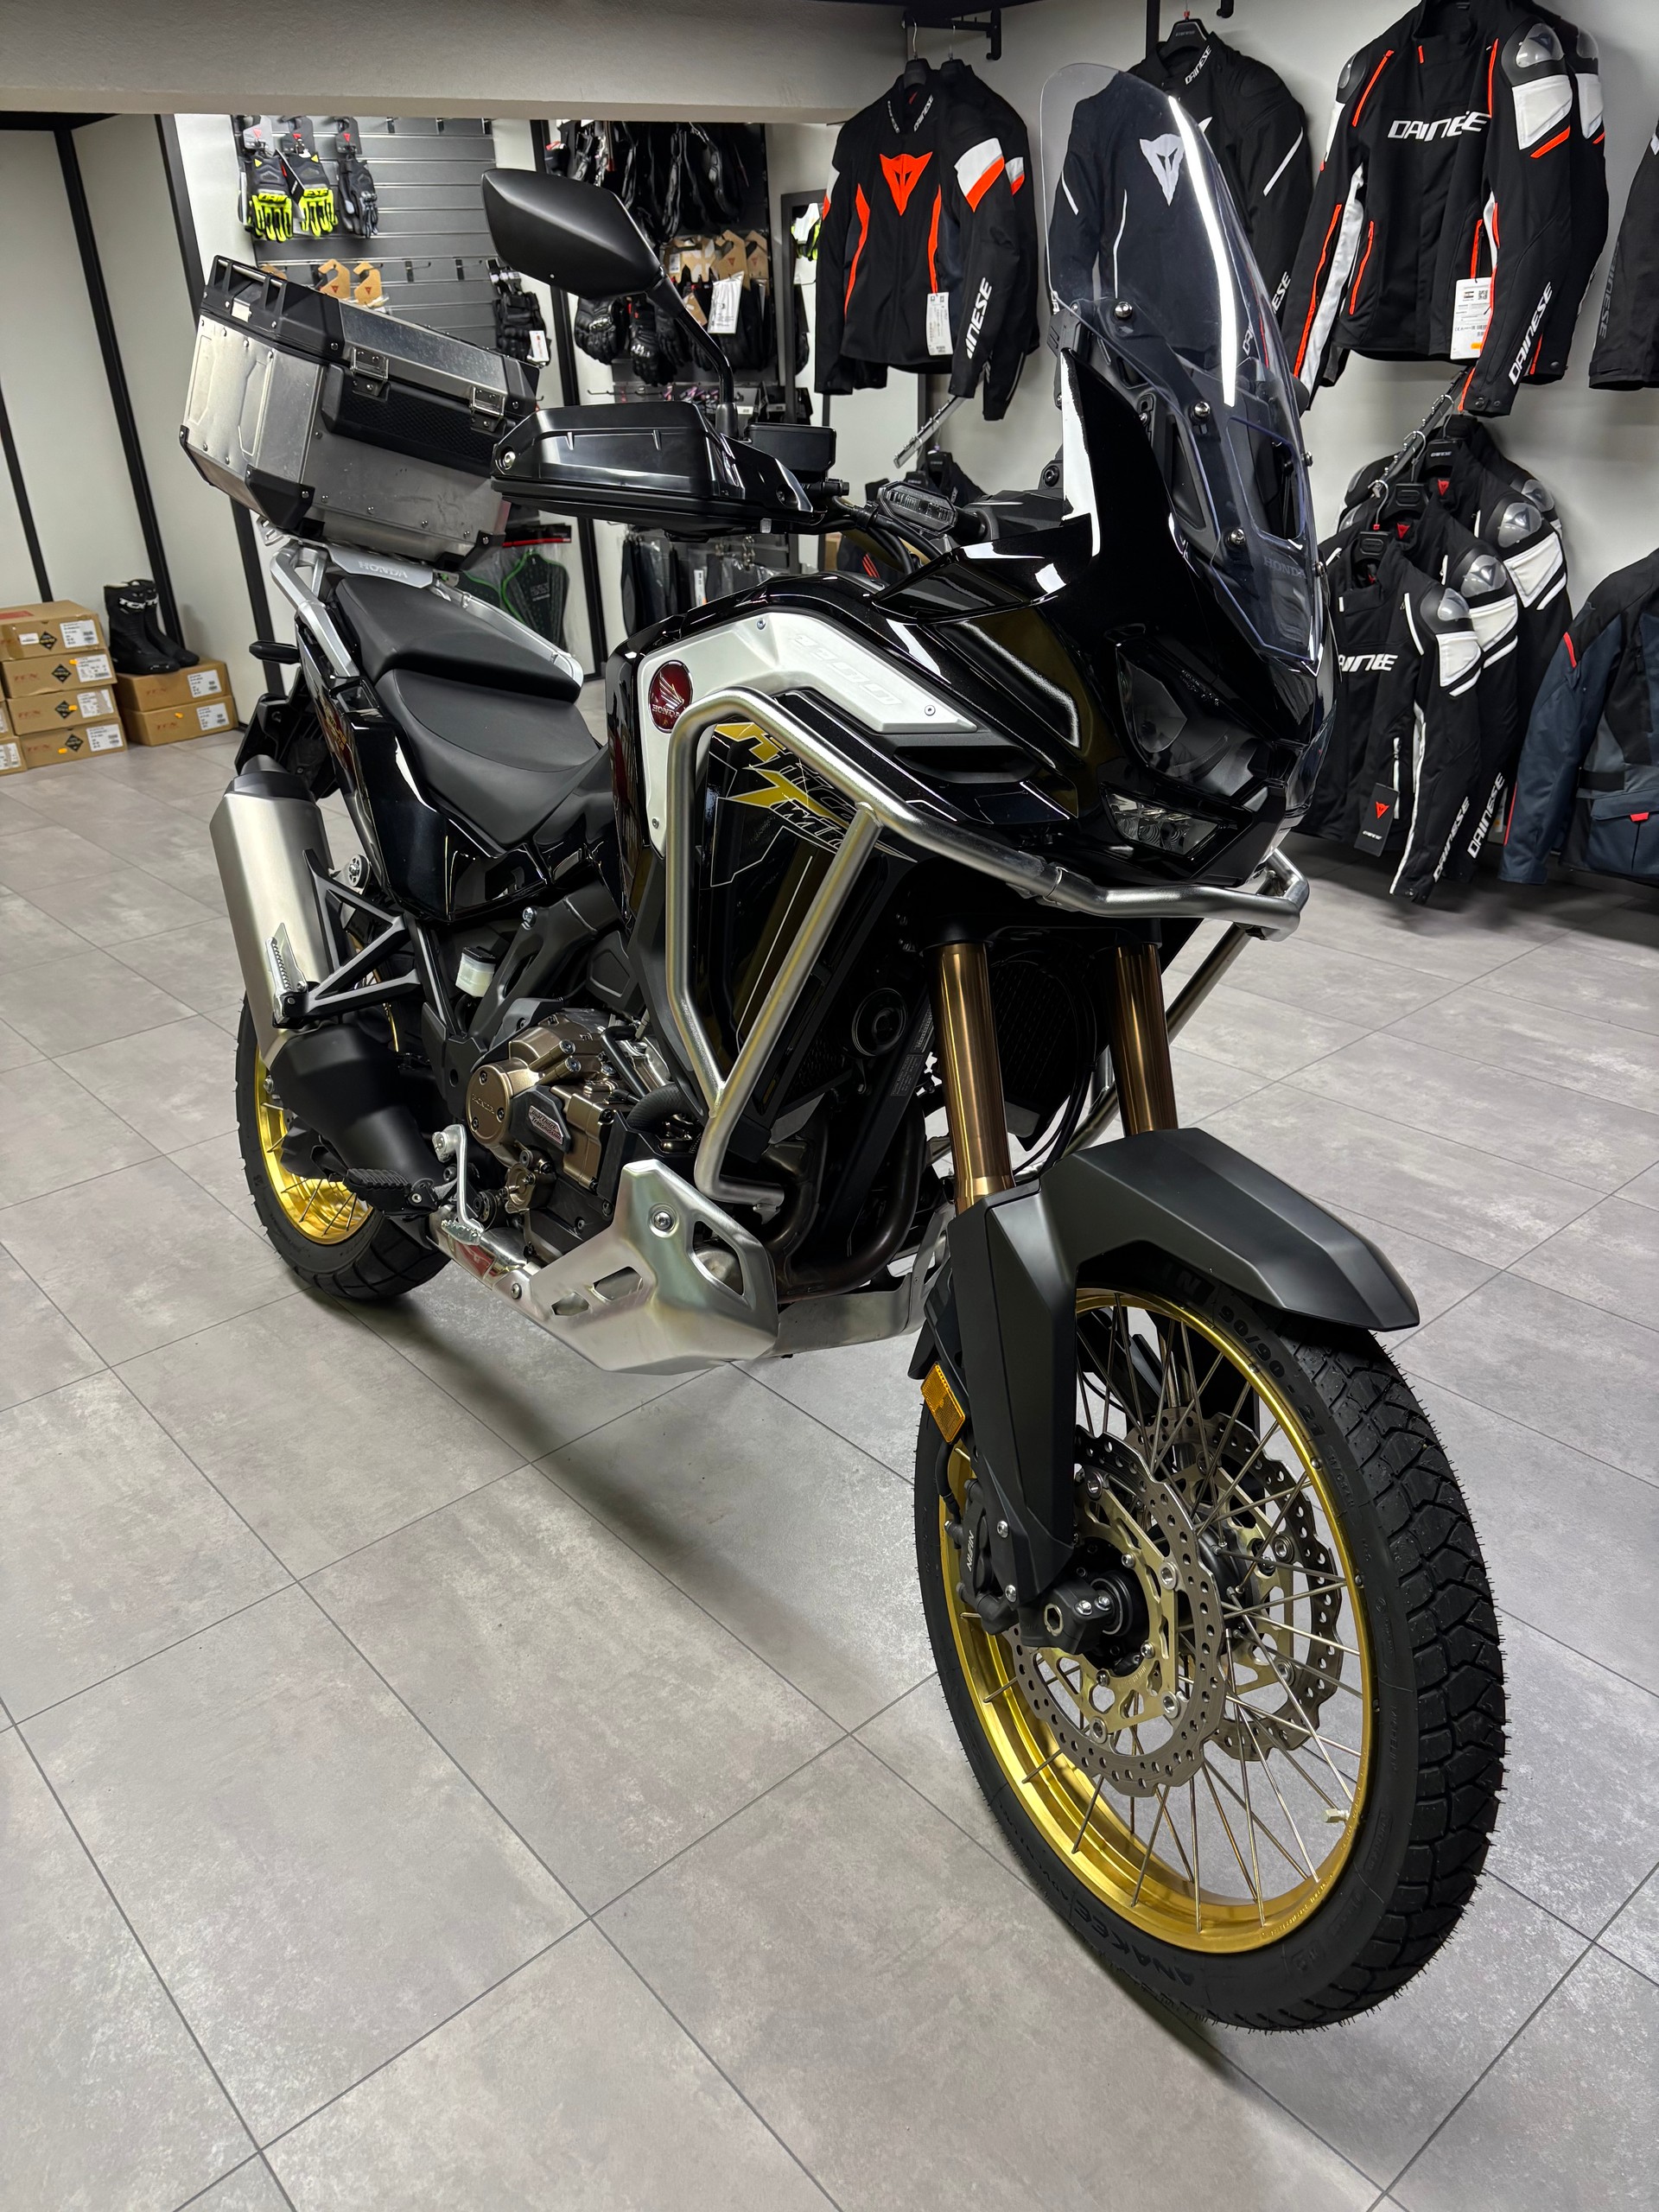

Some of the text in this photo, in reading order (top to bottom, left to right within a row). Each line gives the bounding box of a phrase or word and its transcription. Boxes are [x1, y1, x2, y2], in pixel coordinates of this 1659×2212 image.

[1185, 45, 1212, 85] DAINESE
[1509, 282, 1553, 385] DAINESE
[359, 561, 409, 578] HONDA
[1262, 556, 1307, 580] HONDA
[1433, 796, 1471, 883] DAINESE
[1466, 772, 1505, 854] DAINESE
